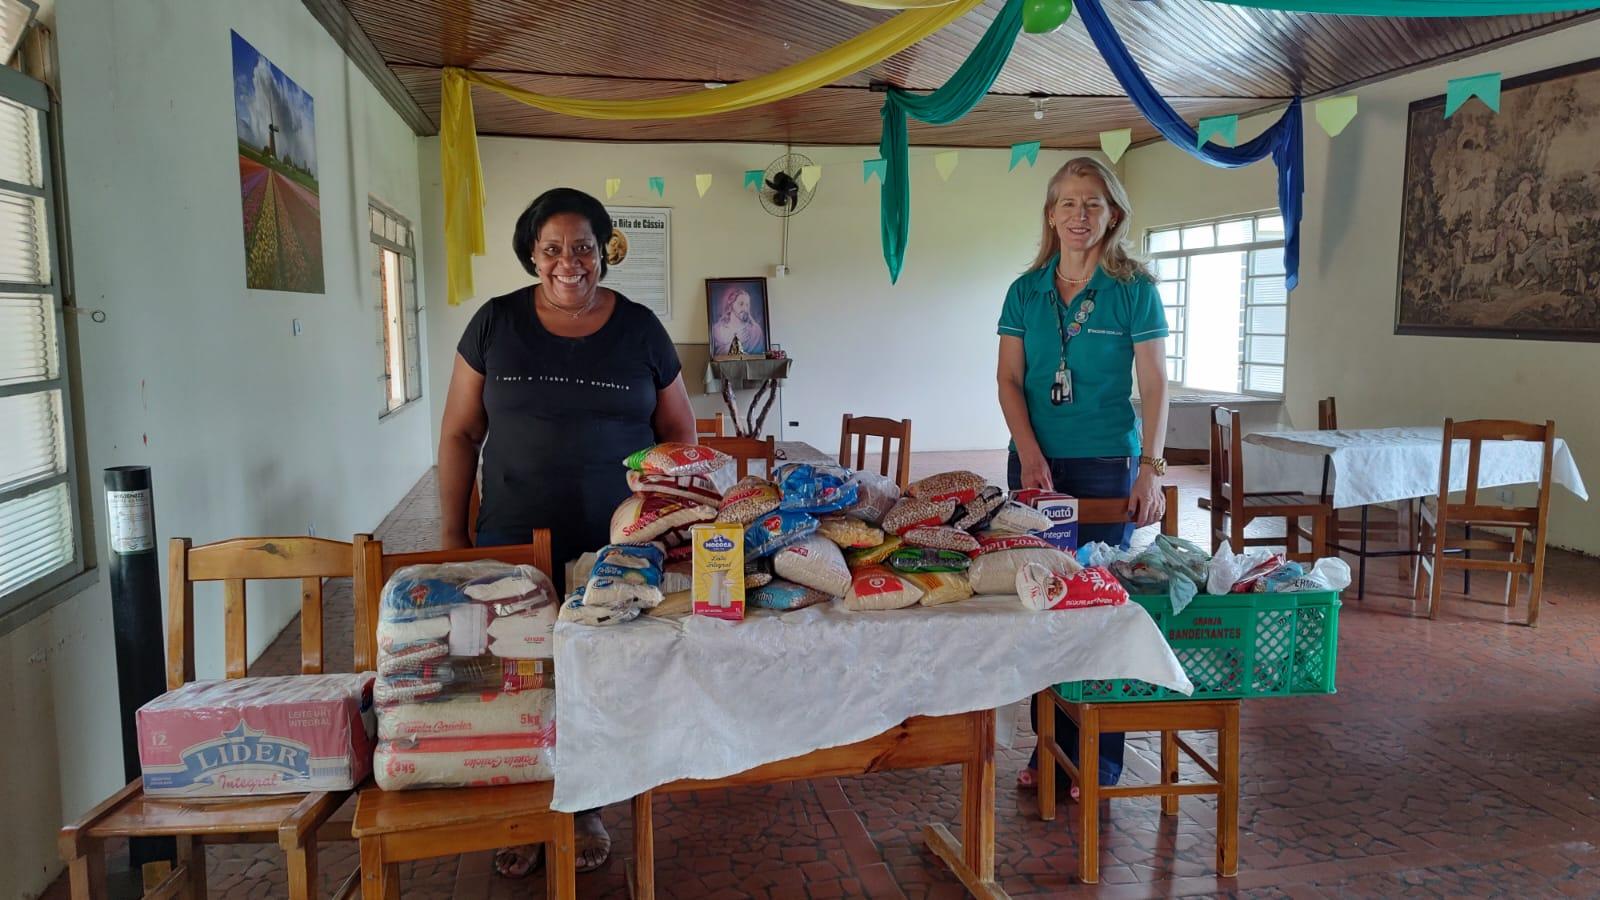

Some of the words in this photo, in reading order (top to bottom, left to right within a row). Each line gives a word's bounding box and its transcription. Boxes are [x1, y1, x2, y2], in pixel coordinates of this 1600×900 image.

[618, 219, 632, 228] Rita
[633, 219, 642, 228] de
[643, 219, 665, 229] Cássia
[1043, 506, 1072, 518] Quatá
[1043, 530, 1072, 539] Integral
[288, 710, 314, 719] LEITE
[520, 713, 541, 725] 5kg
[288, 718, 332, 728] INTEGRAL
[152, 734, 169, 746] 12
[196, 742, 297, 770] LIDER
[218, 773, 278, 790] Integral
